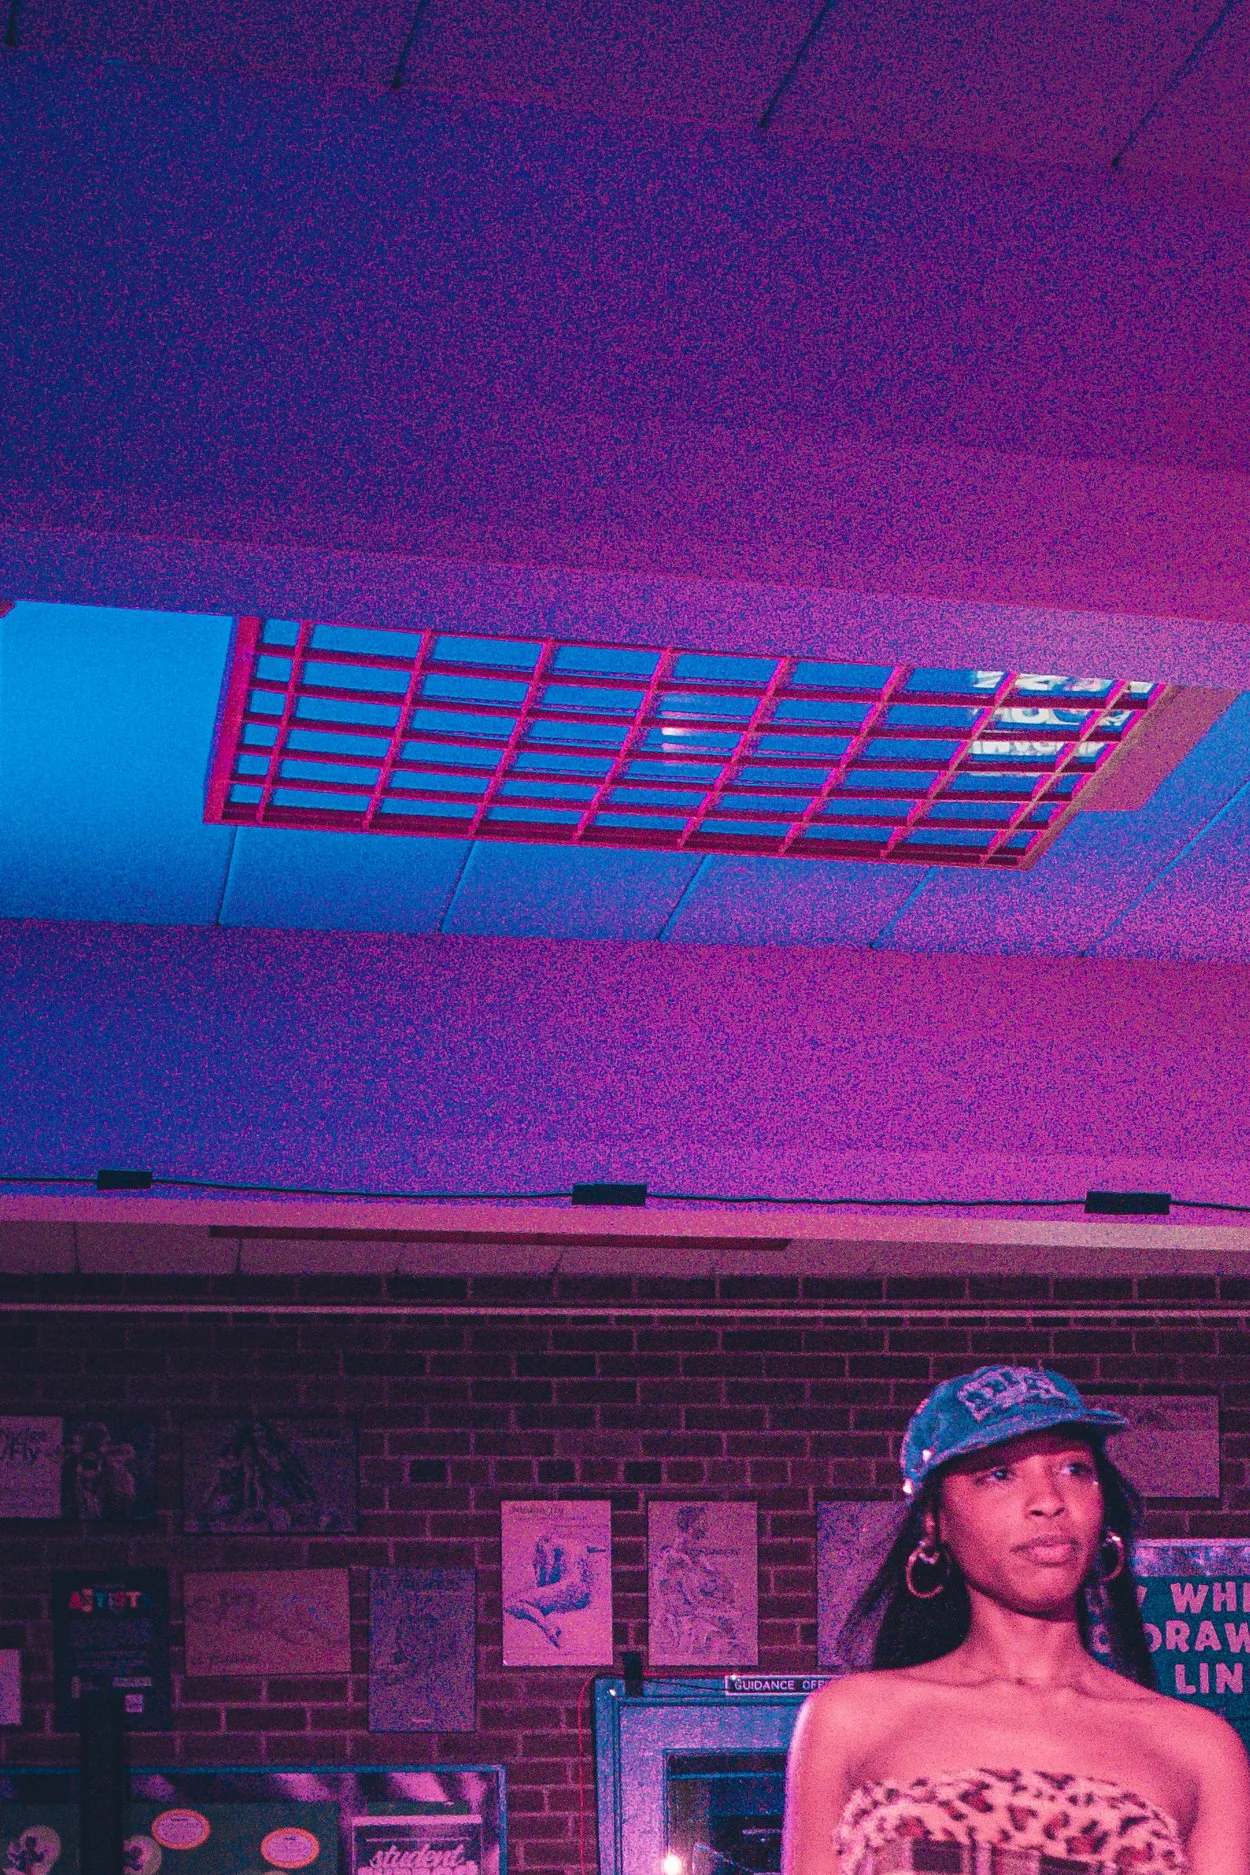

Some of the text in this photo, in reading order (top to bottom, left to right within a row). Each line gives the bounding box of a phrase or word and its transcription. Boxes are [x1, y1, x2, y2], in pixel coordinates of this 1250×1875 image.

[734, 1679, 827, 1691] GUIDANCE OFF
[369, 1843, 465, 1868] student
